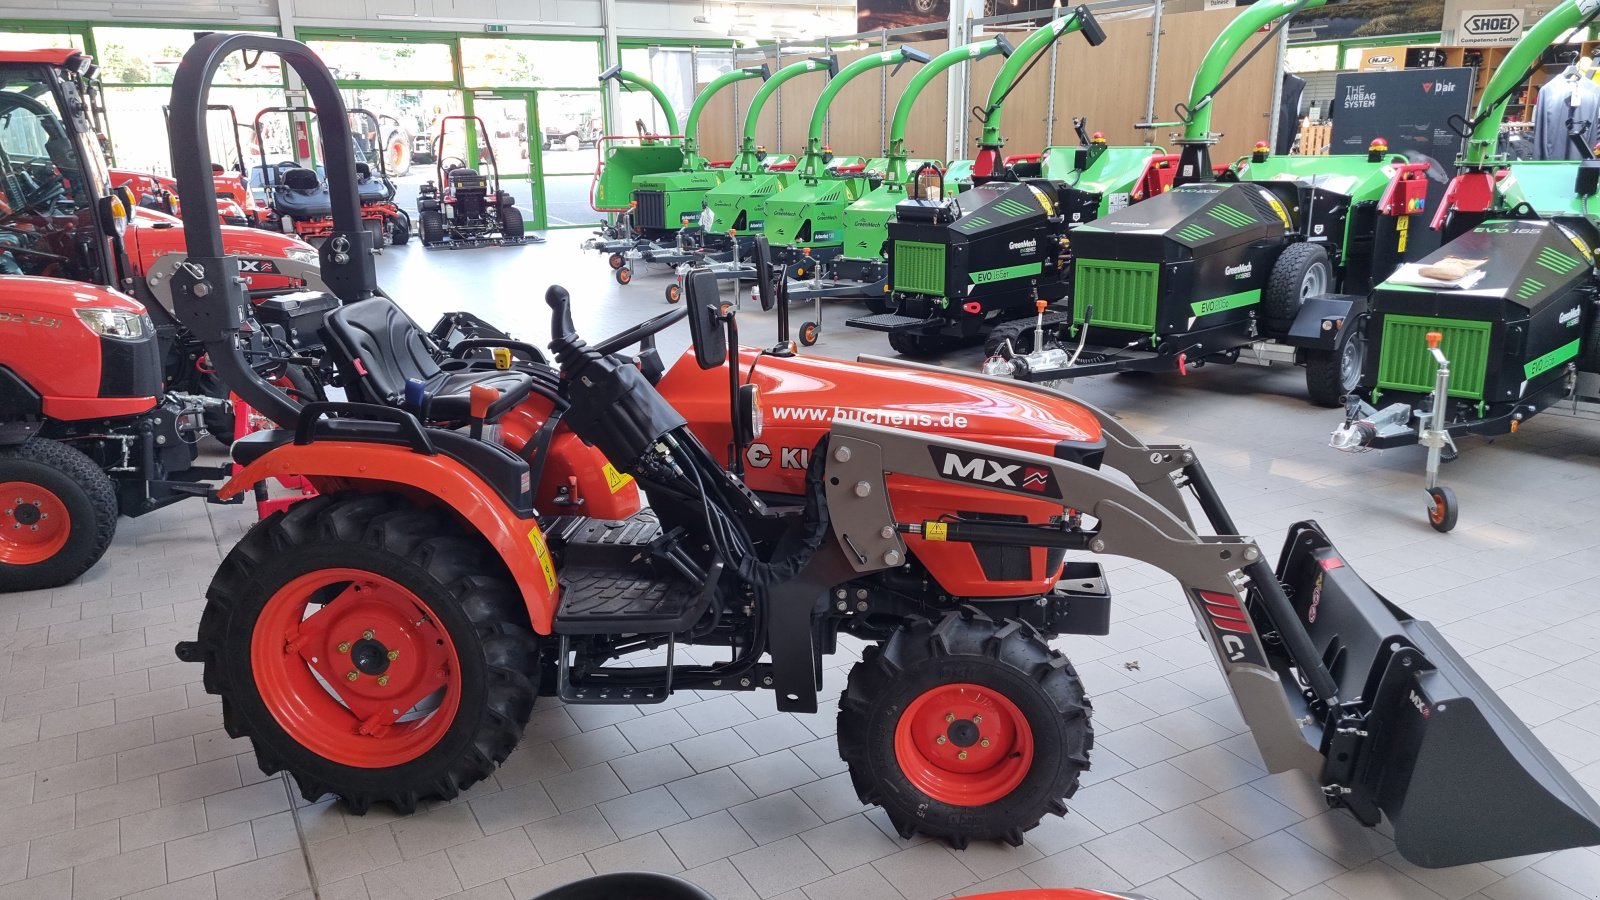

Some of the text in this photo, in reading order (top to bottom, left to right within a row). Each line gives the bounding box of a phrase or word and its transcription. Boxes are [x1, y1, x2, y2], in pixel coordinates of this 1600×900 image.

[1472, 18, 1512, 31] SHOEI
[1346, 85, 1365, 94] THE
[1345, 93, 1376, 101] AIRBAG
[1344, 100, 1375, 108] SYSTEM
[1009, 238, 1037, 250] GreenMech
[1225, 262, 1252, 276] GreenMech
[978, 272, 992, 282] EVO
[1201, 302, 1214, 313] EVO
[1531, 361, 1543, 375] EVO
[772, 406, 968, 428] www.buchens.de
[942, 453, 1021, 487] MX
[1222, 635, 1245, 661] C1
[1409, 689, 1425, 713] MX
